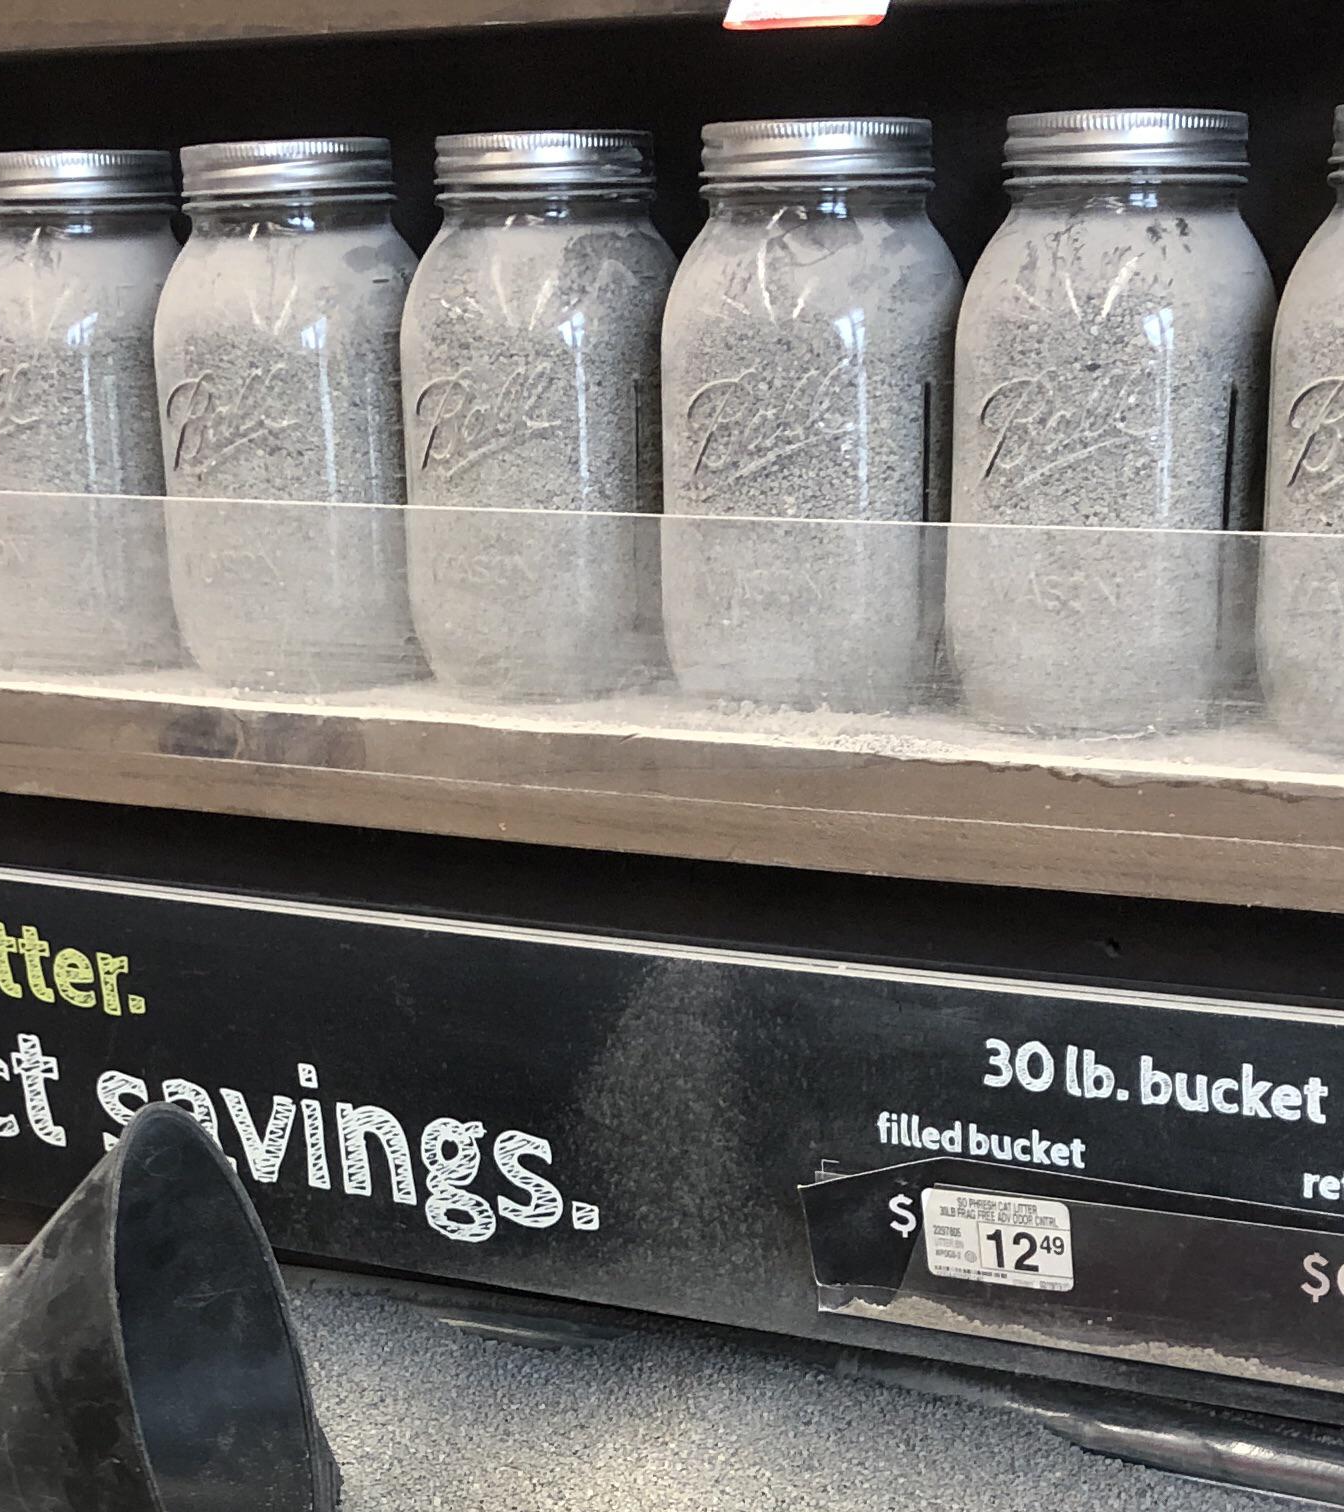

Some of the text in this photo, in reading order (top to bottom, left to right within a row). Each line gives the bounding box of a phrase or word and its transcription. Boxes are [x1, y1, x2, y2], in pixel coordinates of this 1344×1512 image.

[983, 1037, 1329, 1125] 30 lb. bucket
[876, 1111, 1086, 1169] filled bucket
